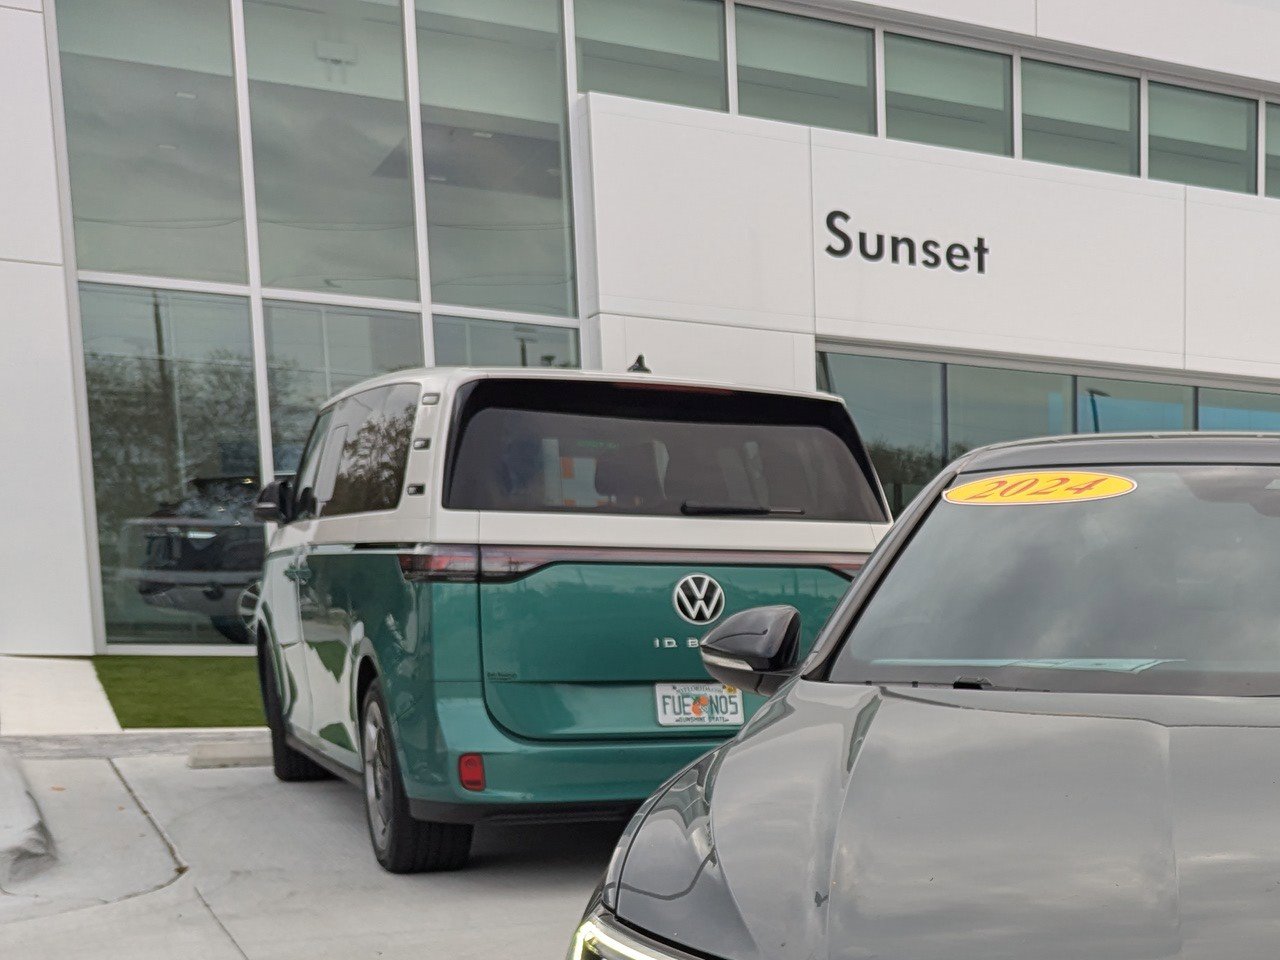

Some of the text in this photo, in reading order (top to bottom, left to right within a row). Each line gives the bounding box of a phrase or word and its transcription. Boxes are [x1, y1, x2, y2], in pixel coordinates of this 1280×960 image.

[825, 210, 989, 274] Sunset
[965, 477, 1108, 500] 2024
[674, 574, 725, 625] VW
